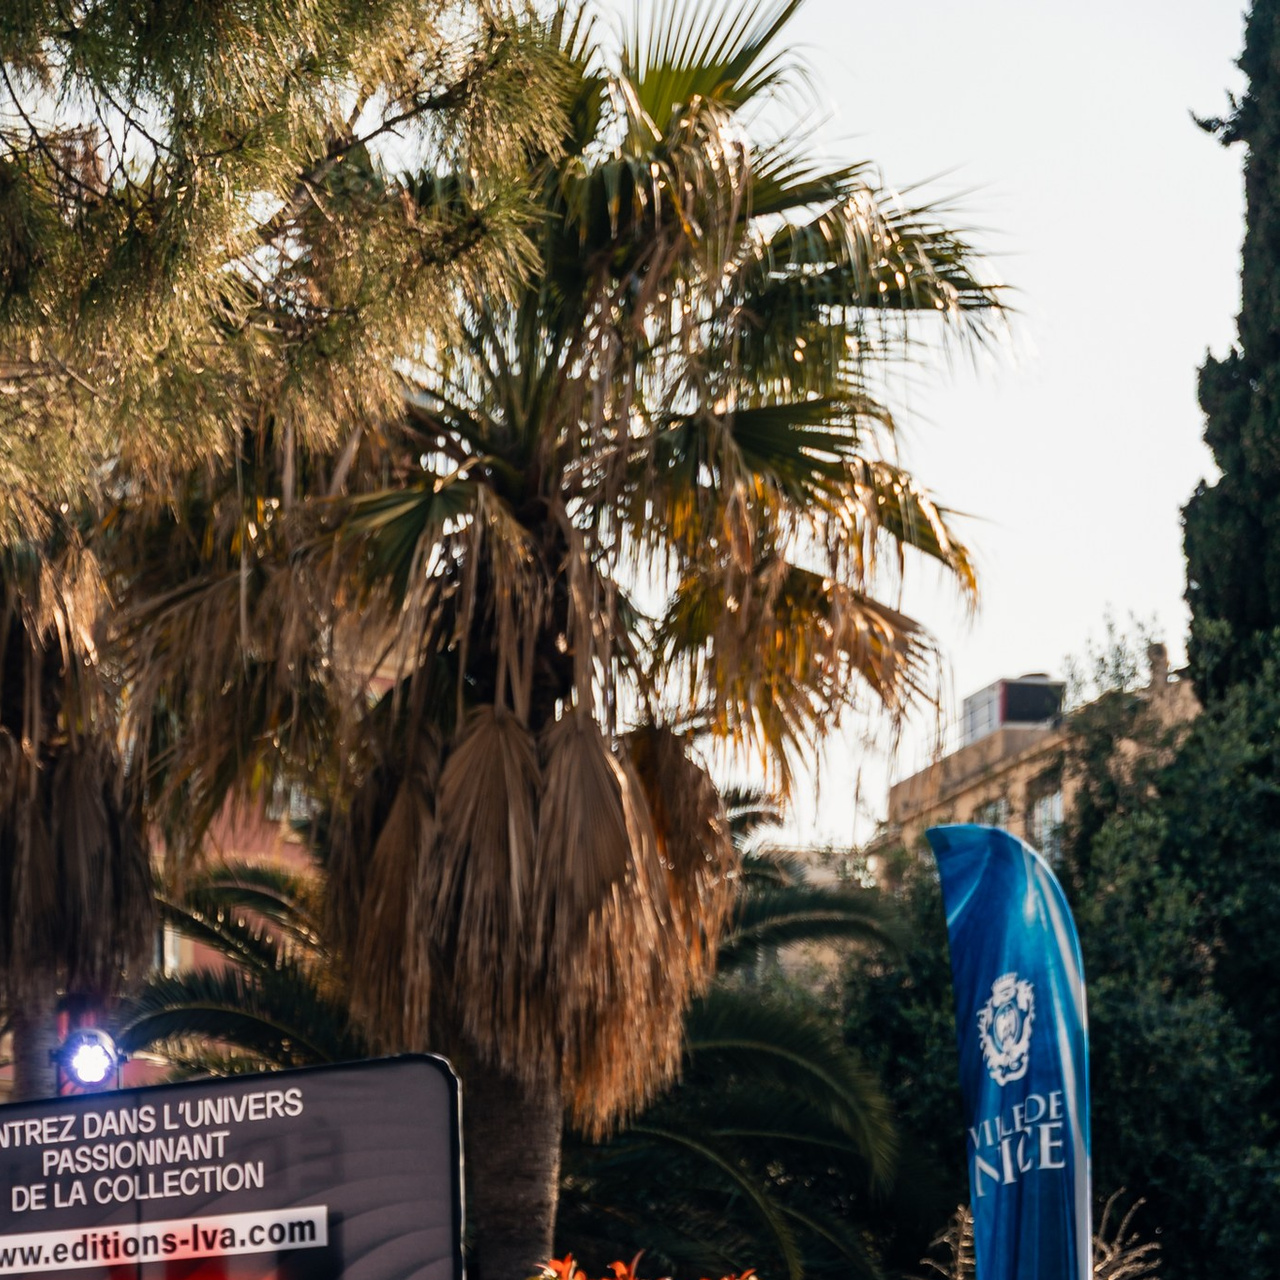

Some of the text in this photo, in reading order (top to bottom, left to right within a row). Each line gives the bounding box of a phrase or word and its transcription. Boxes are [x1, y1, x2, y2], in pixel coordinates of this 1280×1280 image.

[82, 1103, 156, 1140] DANS
[163, 1087, 304, 1131] L'UNIVERS
[1024, 1089, 1063, 1123] DE
[42, 1130, 230, 1177] PASSIONNANT
[11, 1160, 265, 1212] DE LA COLLECTION
